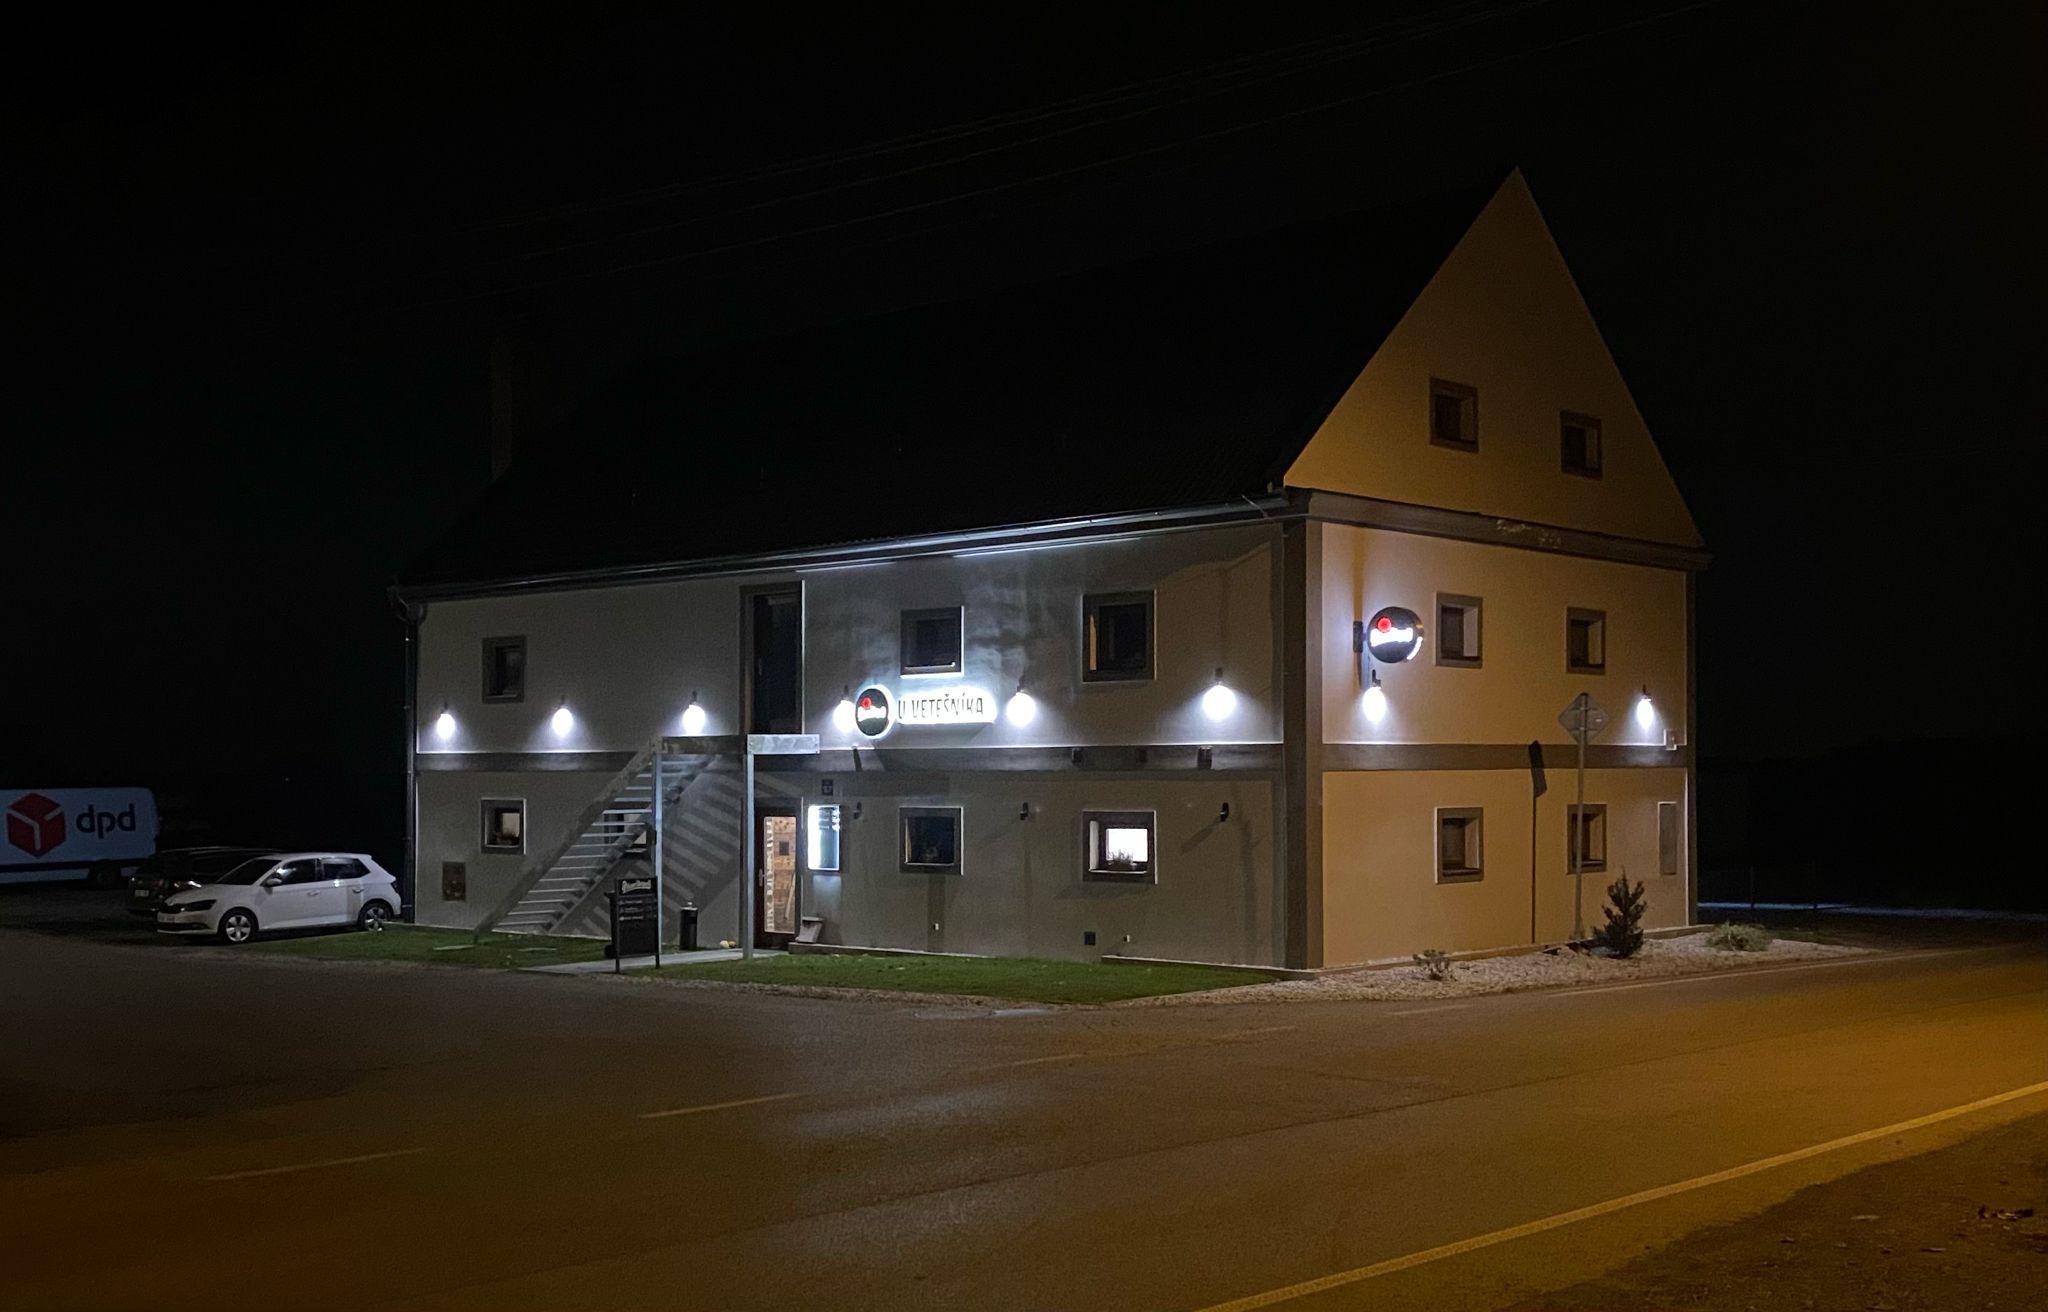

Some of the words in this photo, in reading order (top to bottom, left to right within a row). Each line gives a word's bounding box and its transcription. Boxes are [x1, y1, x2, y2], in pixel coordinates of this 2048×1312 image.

[898, 699, 905, 719] U
[912, 693, 983, 718] VETEŠNÍKA
[76, 804, 135, 839] dpd
